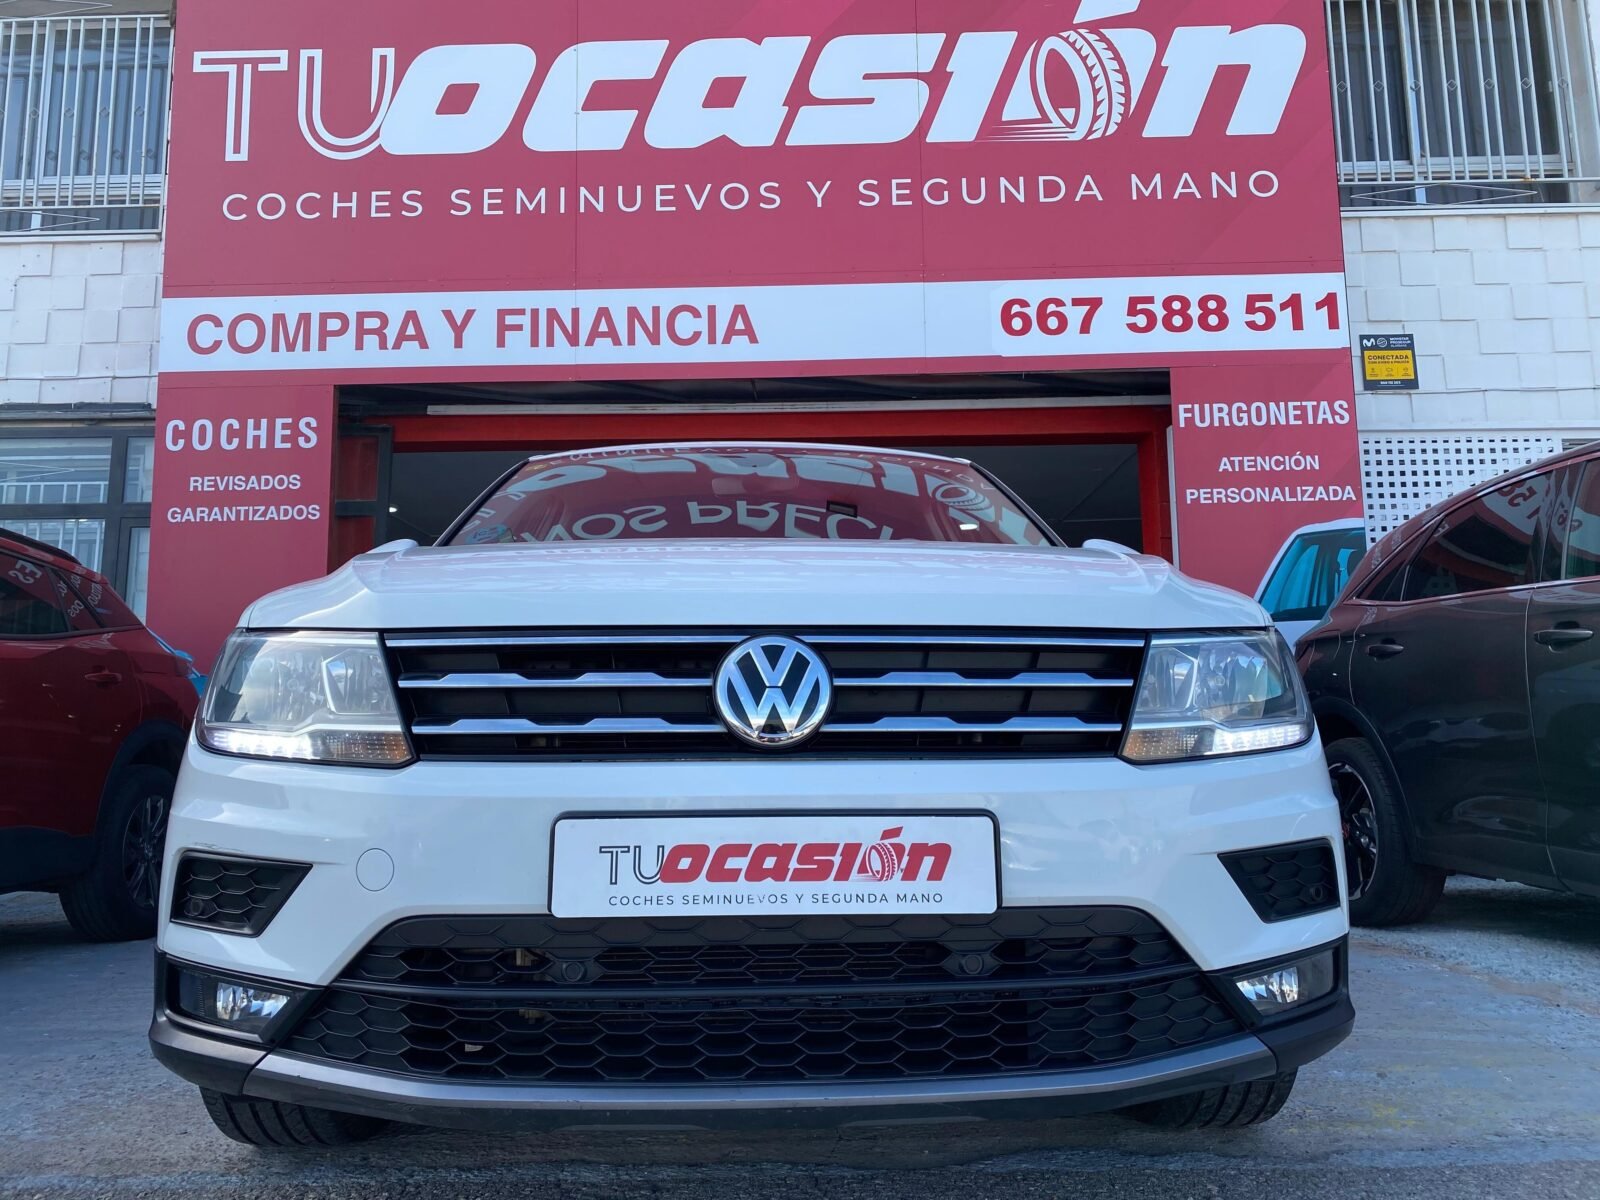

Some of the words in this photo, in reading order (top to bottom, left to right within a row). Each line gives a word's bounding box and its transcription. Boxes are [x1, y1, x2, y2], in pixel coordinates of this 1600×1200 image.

[222, 189, 423, 221] COCHES
[449, 181, 781, 216] SEMINUEVOS
[806, 180, 832, 208] Y
[858, 174, 1104, 207] SEGUNDA
[1130, 170, 1279, 201] MANO
[1000, 297, 1104, 337] 667
[1125, 294, 1230, 334] 588
[1244, 291, 1340, 332] 511
[187, 309, 430, 356] COMPRA
[441, 308, 477, 349] Y
[496, 304, 760, 349] FINANCIA
[1178, 399, 1350, 428] FURGONETAS
[165, 416, 318, 452] COCHES
[1218, 450, 1320, 473] ATENCIÓN
[189, 474, 301, 492] REVISADOS
[1185, 485, 1357, 504] PERSONALIZADA
[167, 504, 321, 523] GARANTIZADOS
[608, 895, 674, 906] COCHES
[682, 893, 789, 905] SEMINUEVOS
[795, 893, 804, 904] Y
[811, 893, 889, 904] SEGUNDA
[896, 892, 944, 904] MANO
